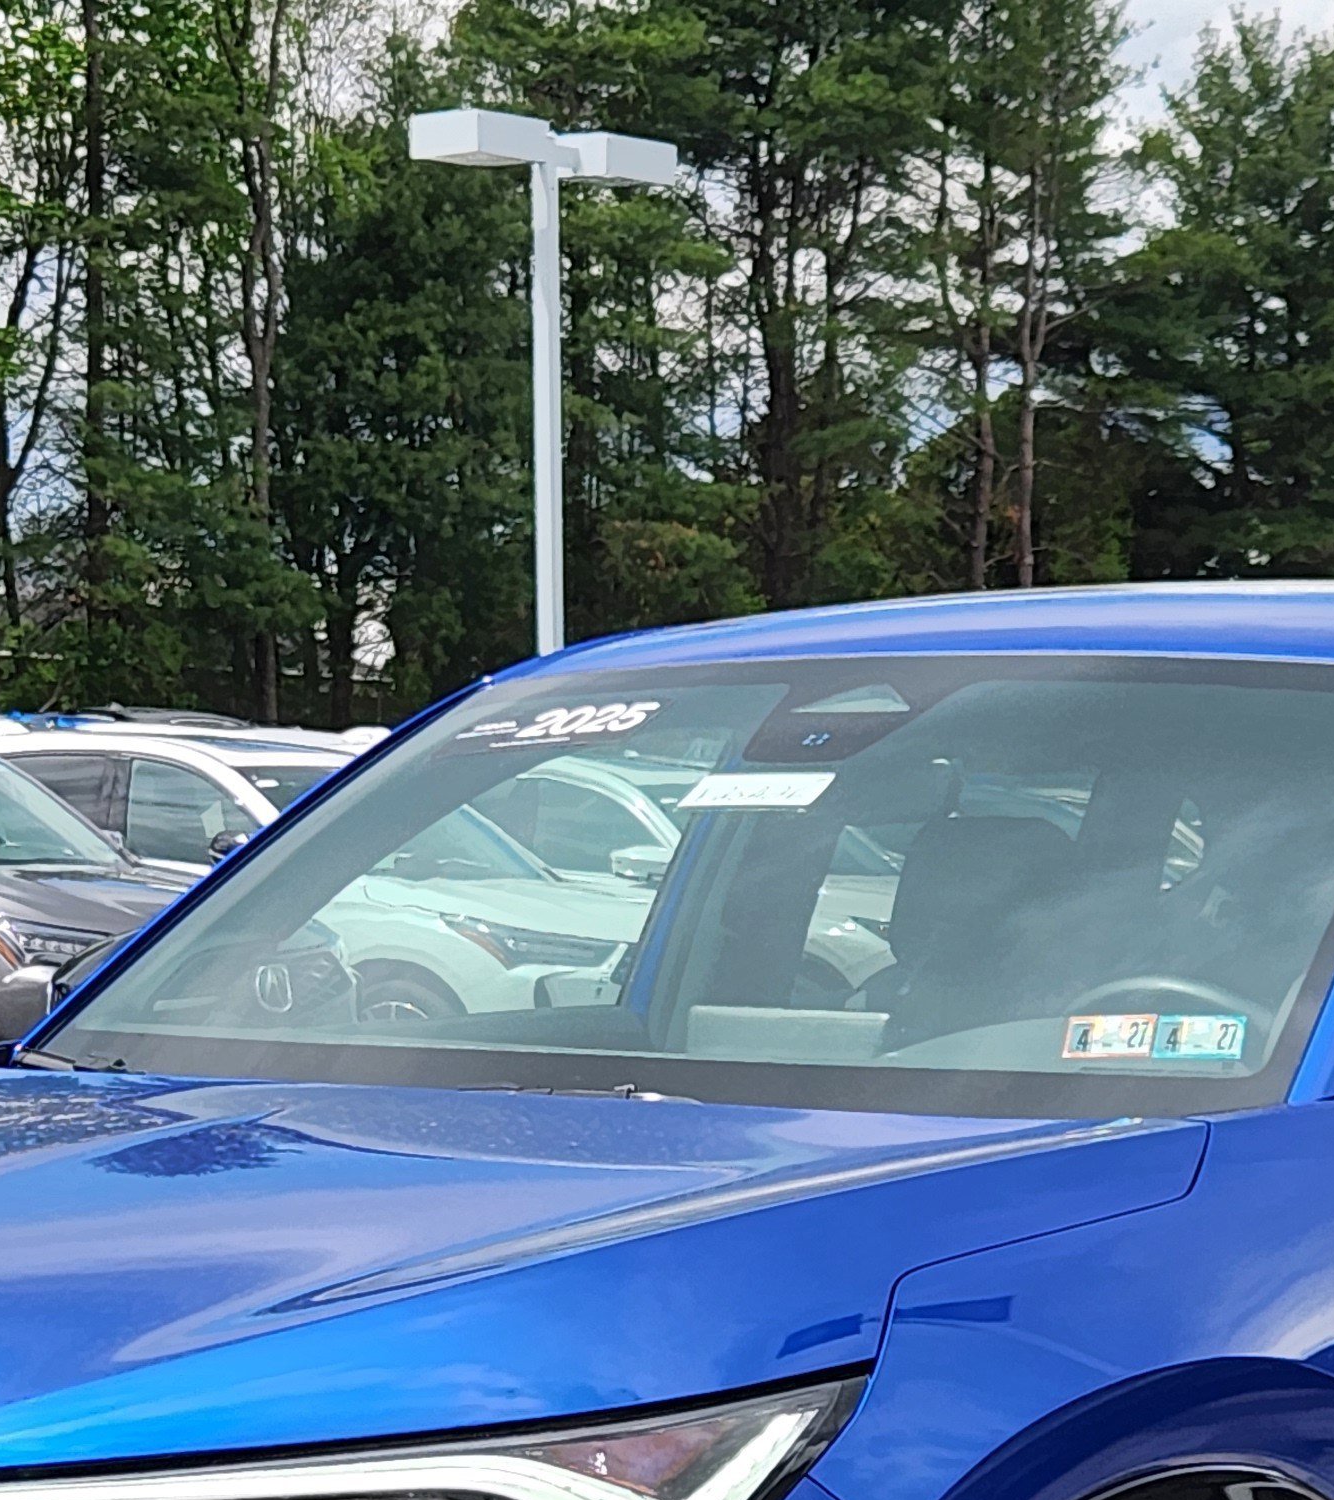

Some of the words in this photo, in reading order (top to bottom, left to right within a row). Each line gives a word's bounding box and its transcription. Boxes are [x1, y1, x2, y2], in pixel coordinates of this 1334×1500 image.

[514, 702, 661, 738] 2025
[1076, 1028, 1090, 1052] 4
[1127, 1021, 1150, 1049] 27
[1165, 1026, 1179, 1052] 4
[1217, 1023, 1239, 1050] 27
